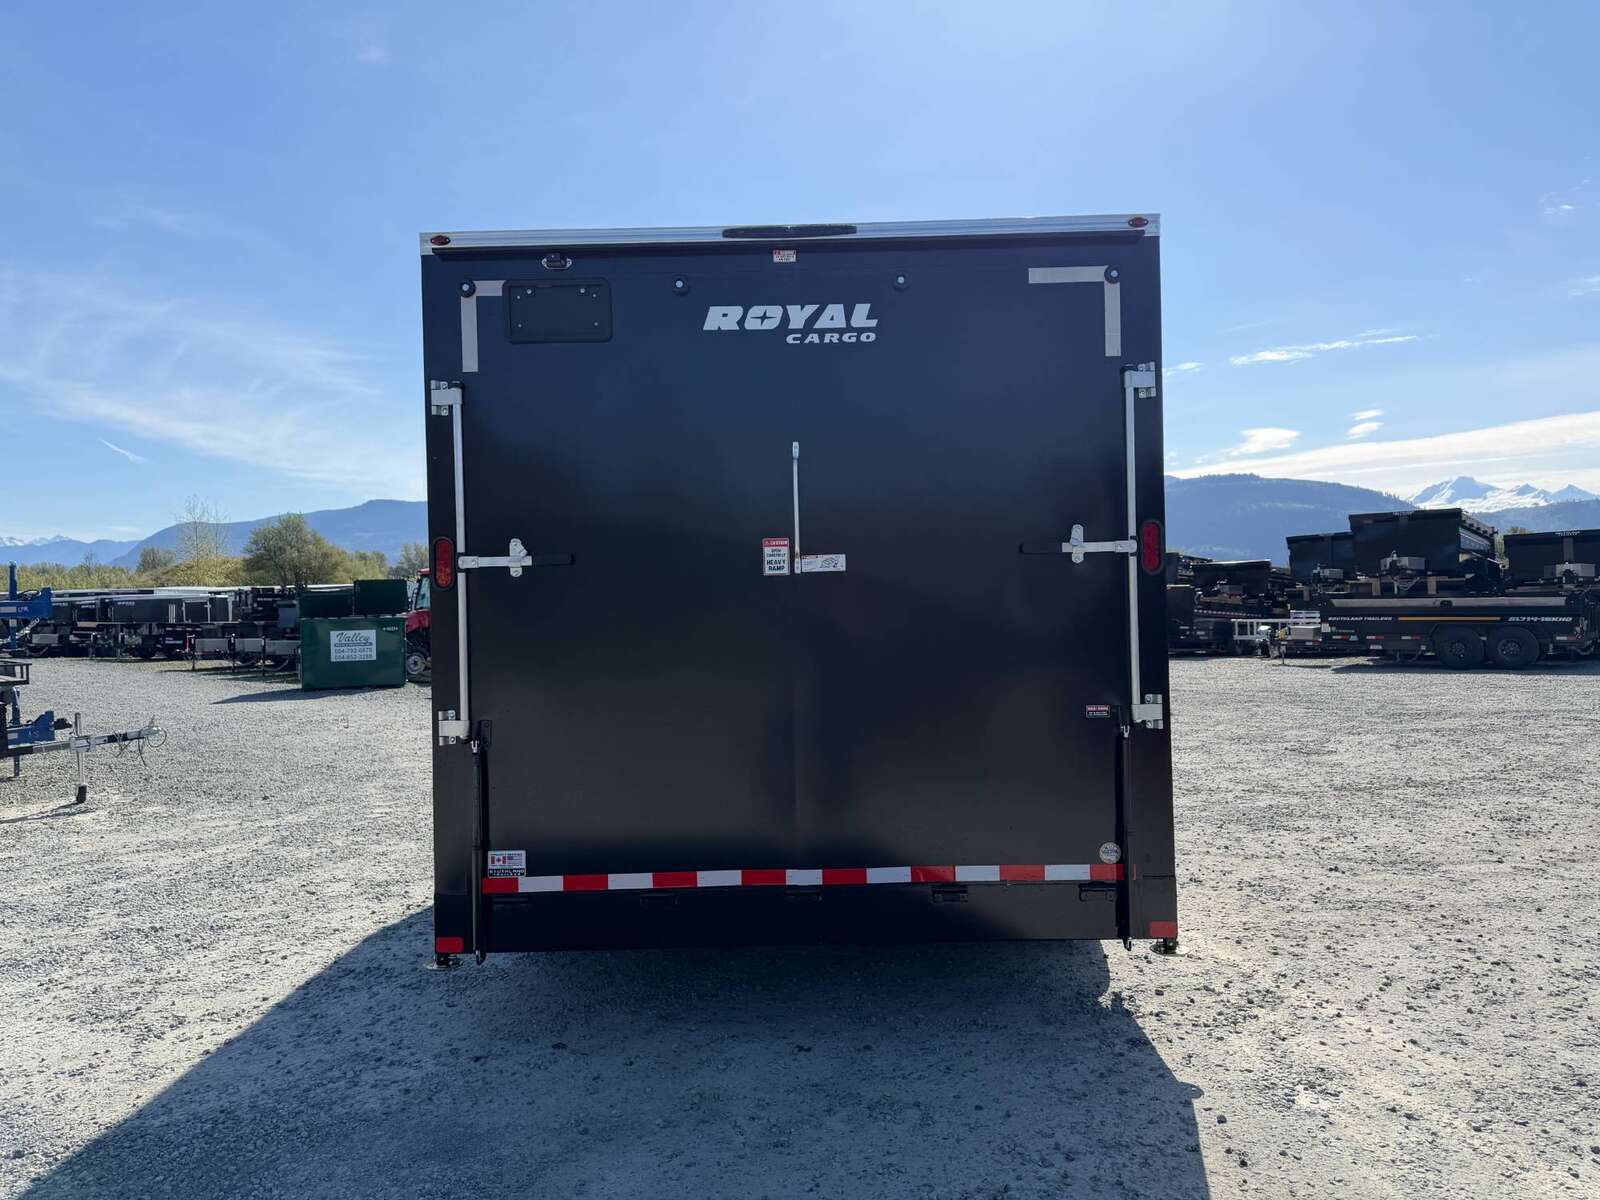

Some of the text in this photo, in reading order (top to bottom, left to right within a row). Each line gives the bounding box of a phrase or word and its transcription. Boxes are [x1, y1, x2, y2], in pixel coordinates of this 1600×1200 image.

[703, 303, 879, 331] ROYAL
[785, 332, 877, 344] CARGO
[336, 631, 370, 643] Valley
